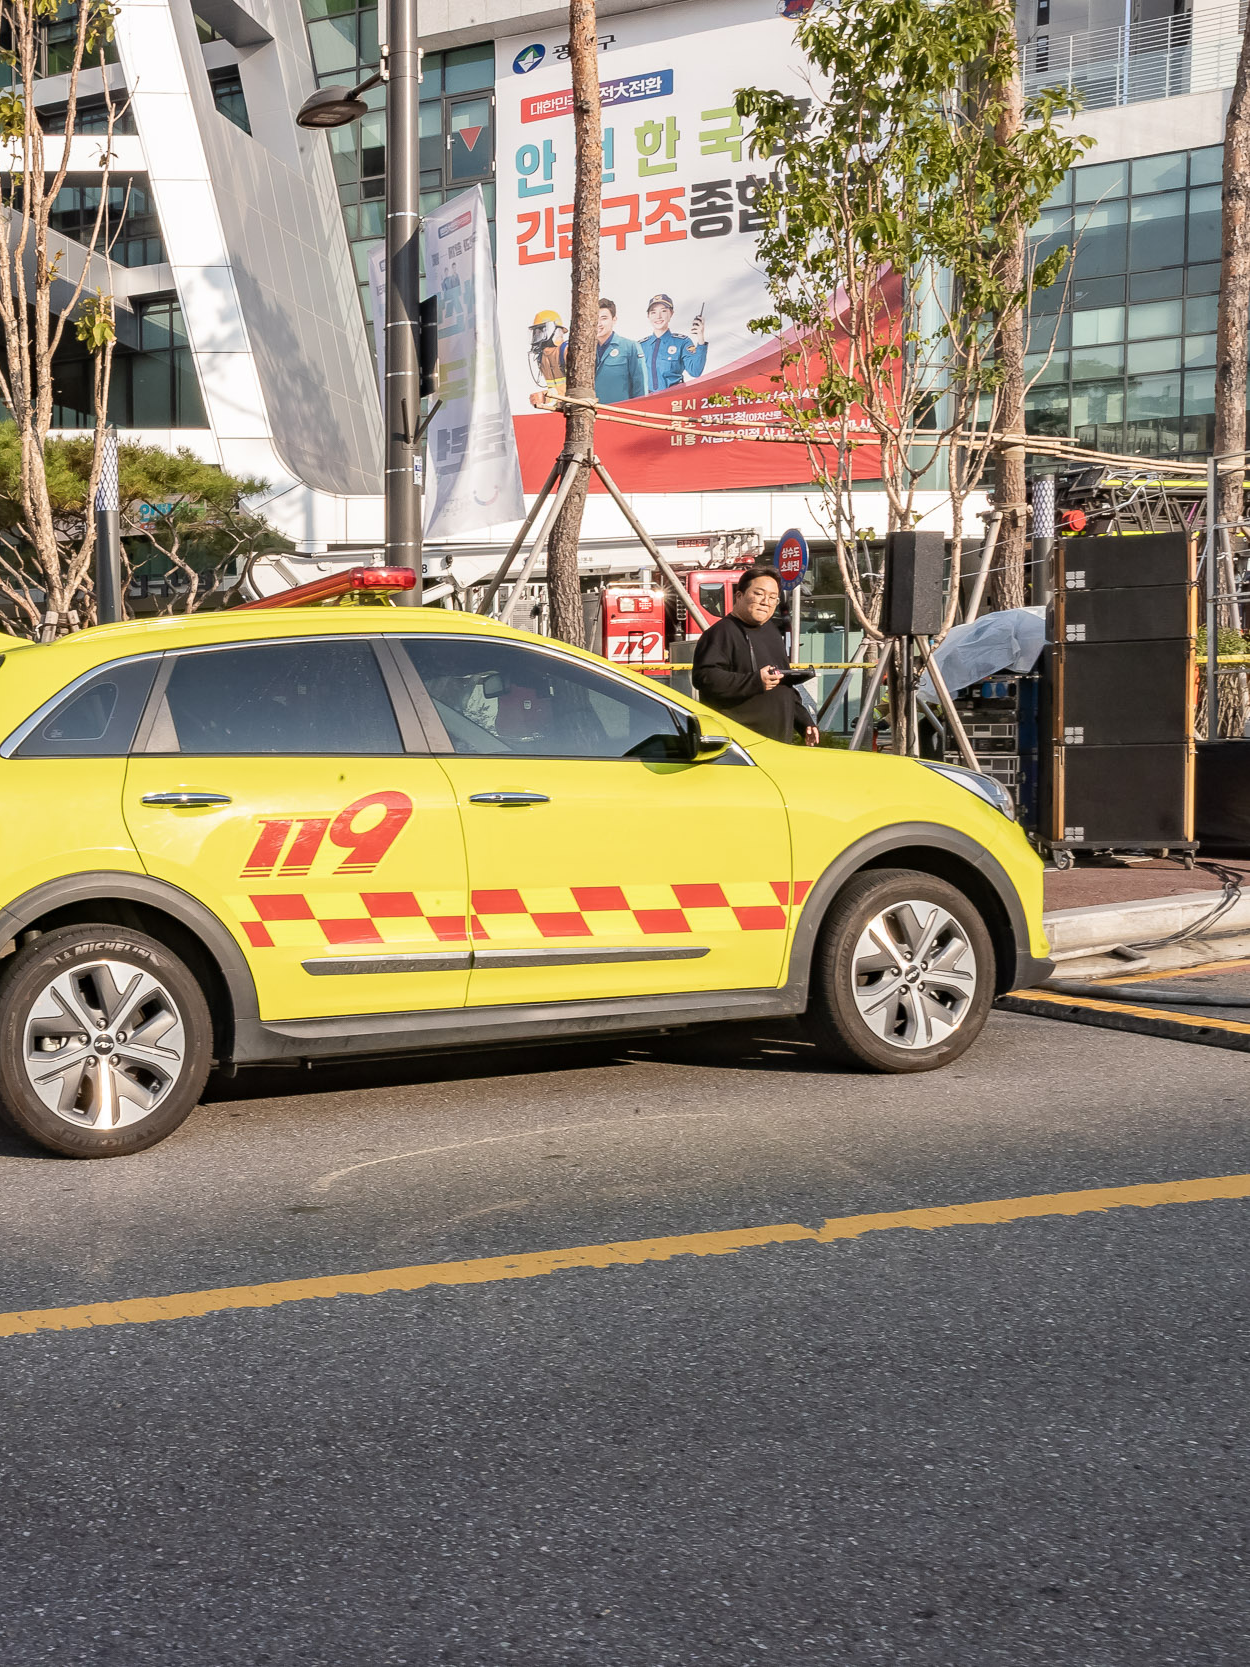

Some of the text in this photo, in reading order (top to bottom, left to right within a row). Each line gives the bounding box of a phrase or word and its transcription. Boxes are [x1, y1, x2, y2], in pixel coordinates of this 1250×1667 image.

[551, 34, 617, 60] 광구
[593, 76, 663, 104] 전大전환
[781, 546, 800, 559] 상수도
[780, 560, 800, 572] 소화전
[611, 633, 660, 657] 119
[238, 790, 413, 879] 119
[74, 941, 151, 959] MICHELIN
